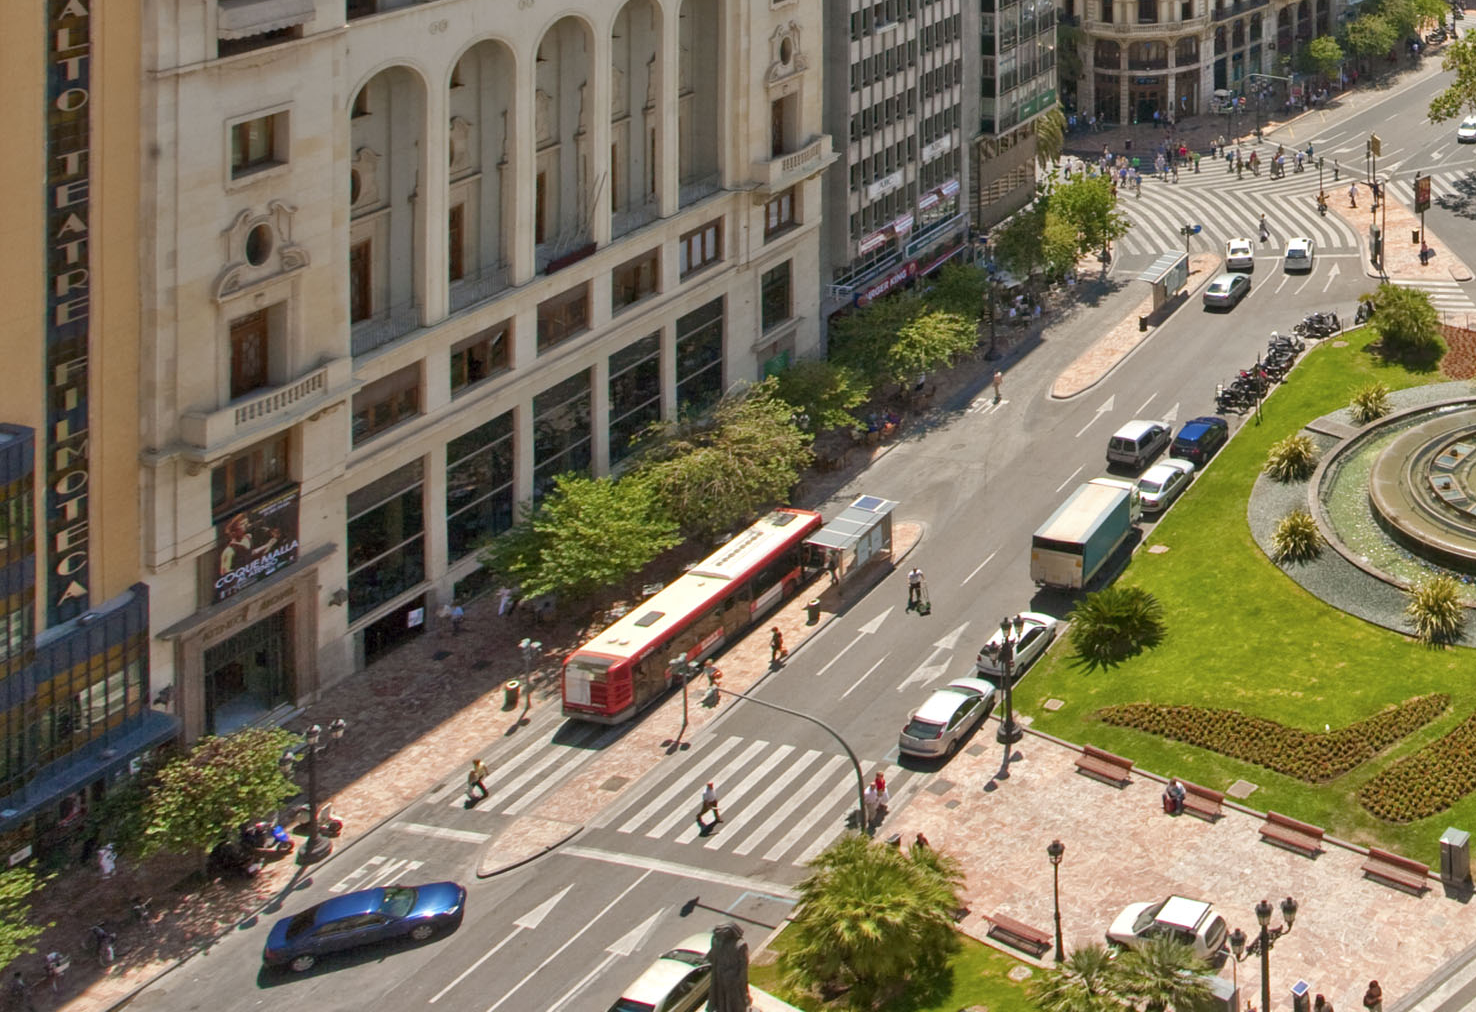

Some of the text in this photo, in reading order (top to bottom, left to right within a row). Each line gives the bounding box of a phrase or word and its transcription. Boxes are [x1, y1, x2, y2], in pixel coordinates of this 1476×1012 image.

[55, 148, 90, 326] TEATRE
[890, 269, 908, 287] KING
[54, 355, 90, 607] FILMOTECA
[215, 558, 261, 589] COQUE
[260, 539, 299, 563] MALLA
[328, 855, 425, 894] EMT
